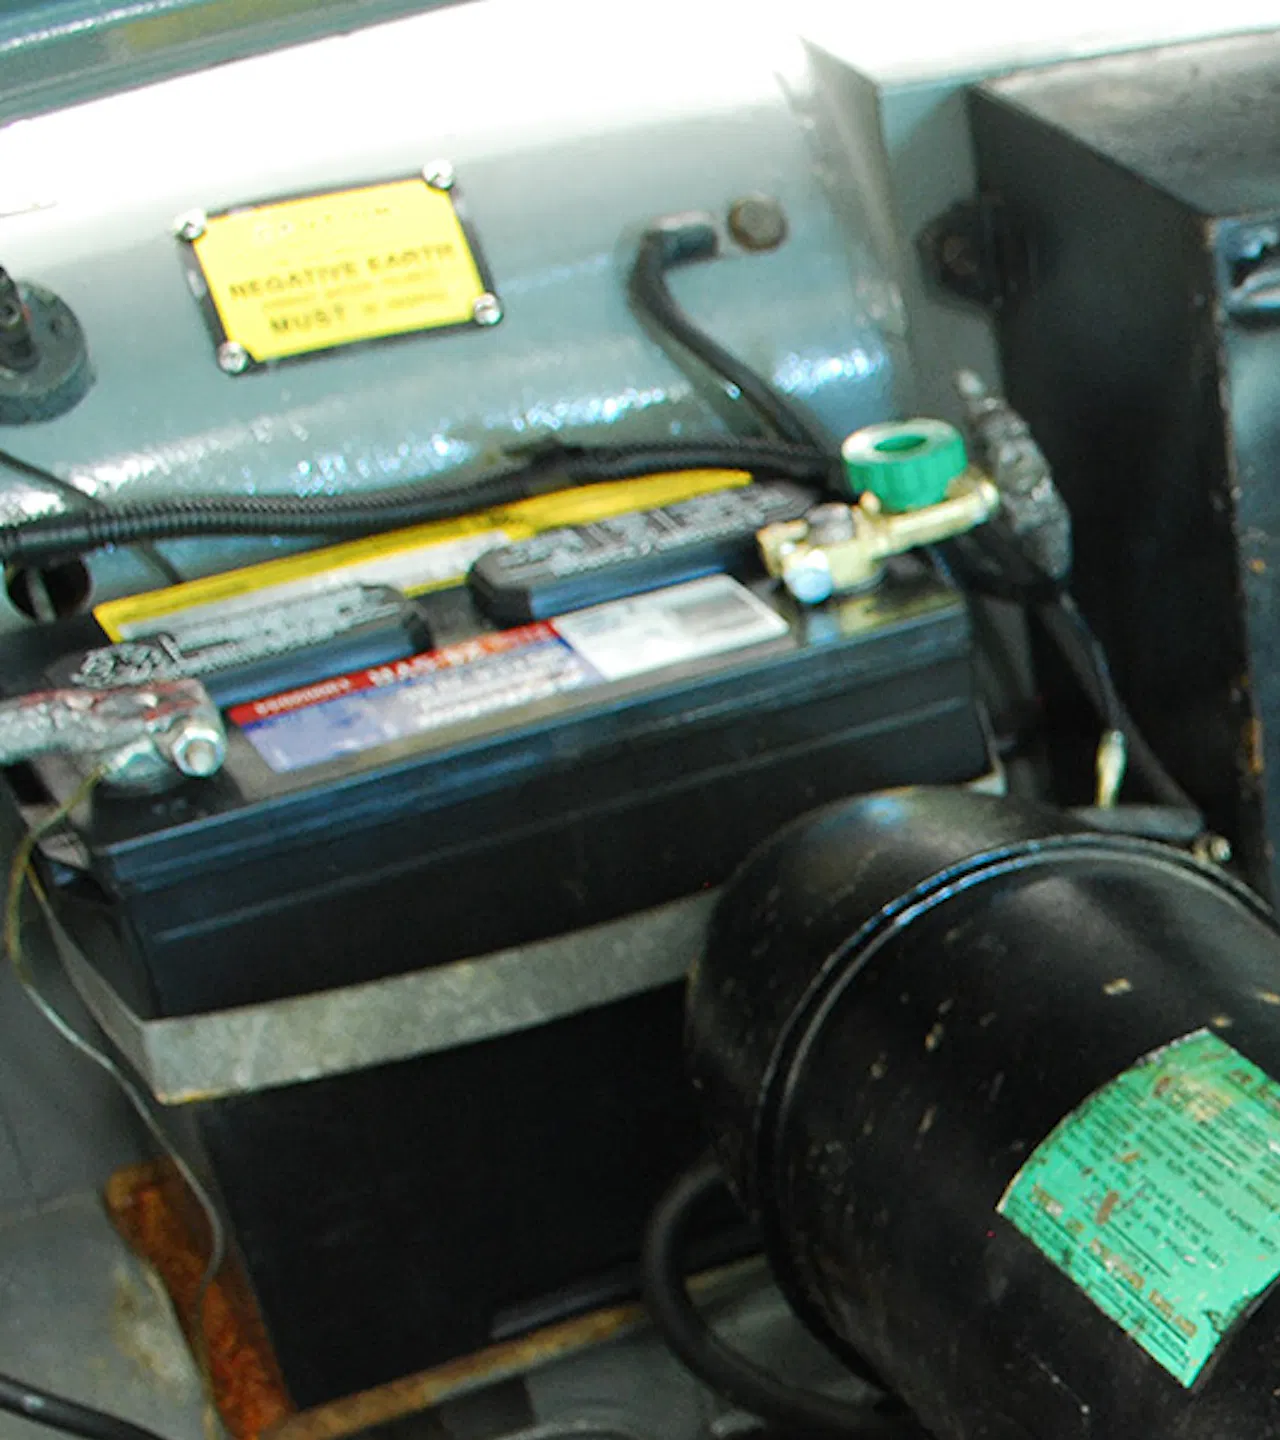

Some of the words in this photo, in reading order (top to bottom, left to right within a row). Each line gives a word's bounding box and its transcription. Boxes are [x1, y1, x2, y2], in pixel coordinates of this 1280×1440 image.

[229, 261, 357, 300] NEGATIVE
[366, 243, 454, 274] EARTH
[269, 302, 346, 334] MUST
